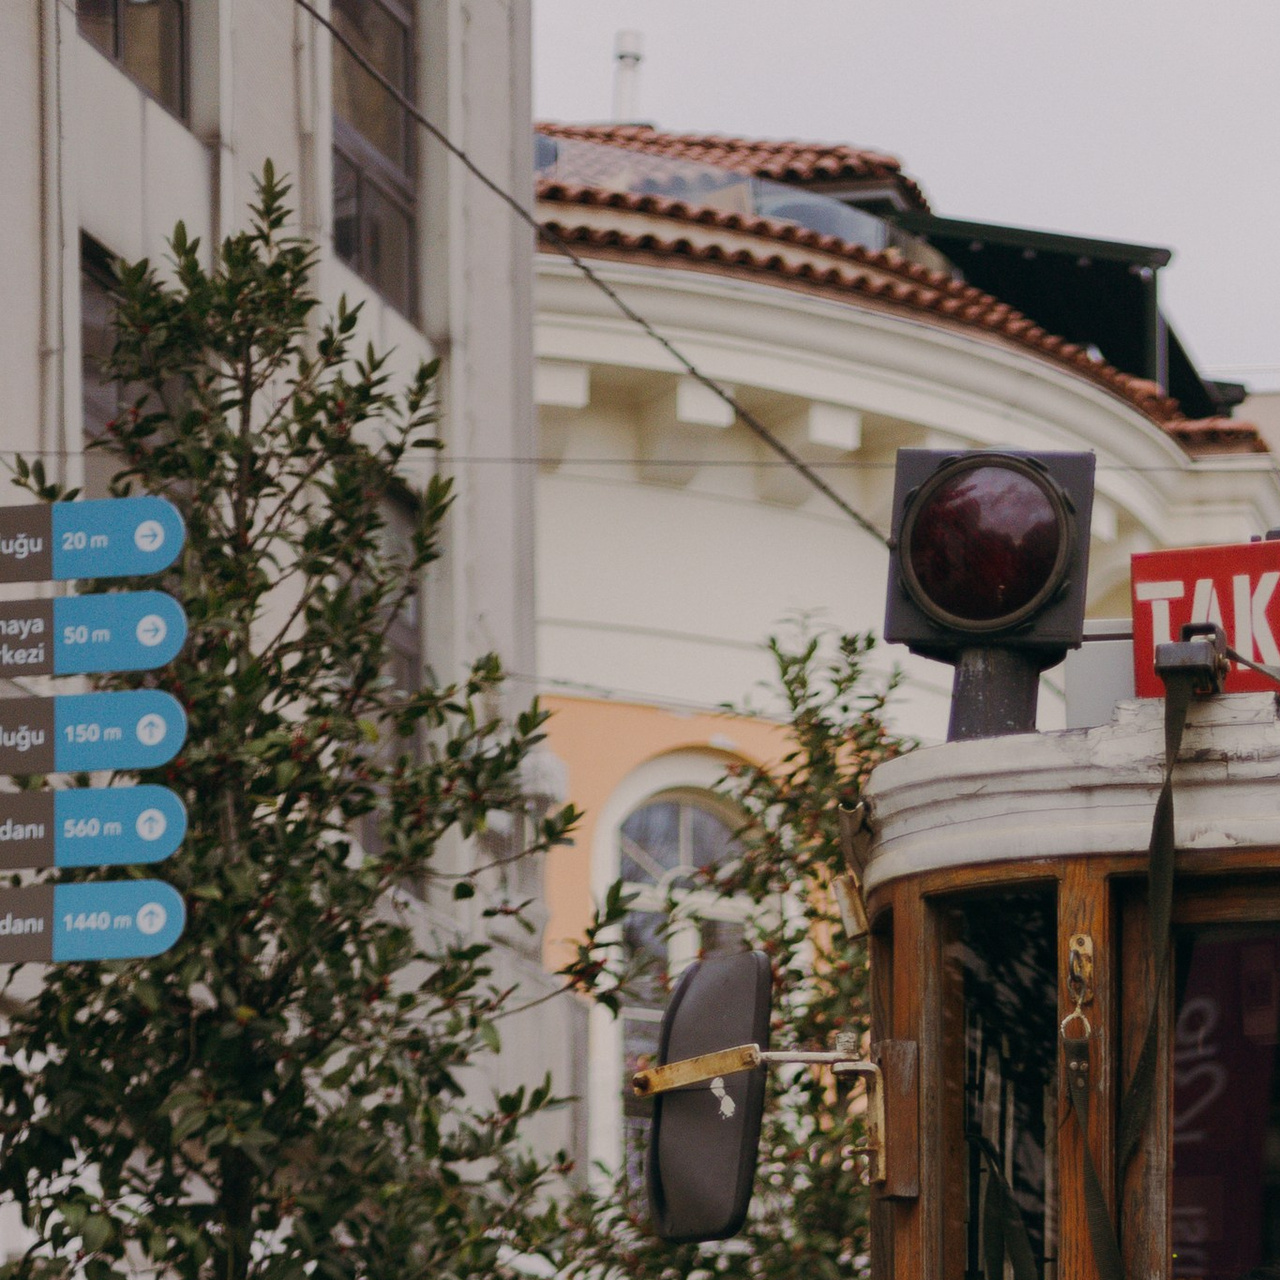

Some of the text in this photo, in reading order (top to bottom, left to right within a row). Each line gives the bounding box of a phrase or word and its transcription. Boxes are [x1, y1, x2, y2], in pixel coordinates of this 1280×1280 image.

[62, 531, 87, 551] 20
[90, 534, 109, 549] m
[63, 624, 111, 645] 50 m
[64, 723, 100, 743] 150
[103, 727, 122, 742] m
[64, 818, 100, 838] 560
[103, 821, 122, 836] m
[63, 911, 111, 931] 1440
[113, 915, 132, 930] m
